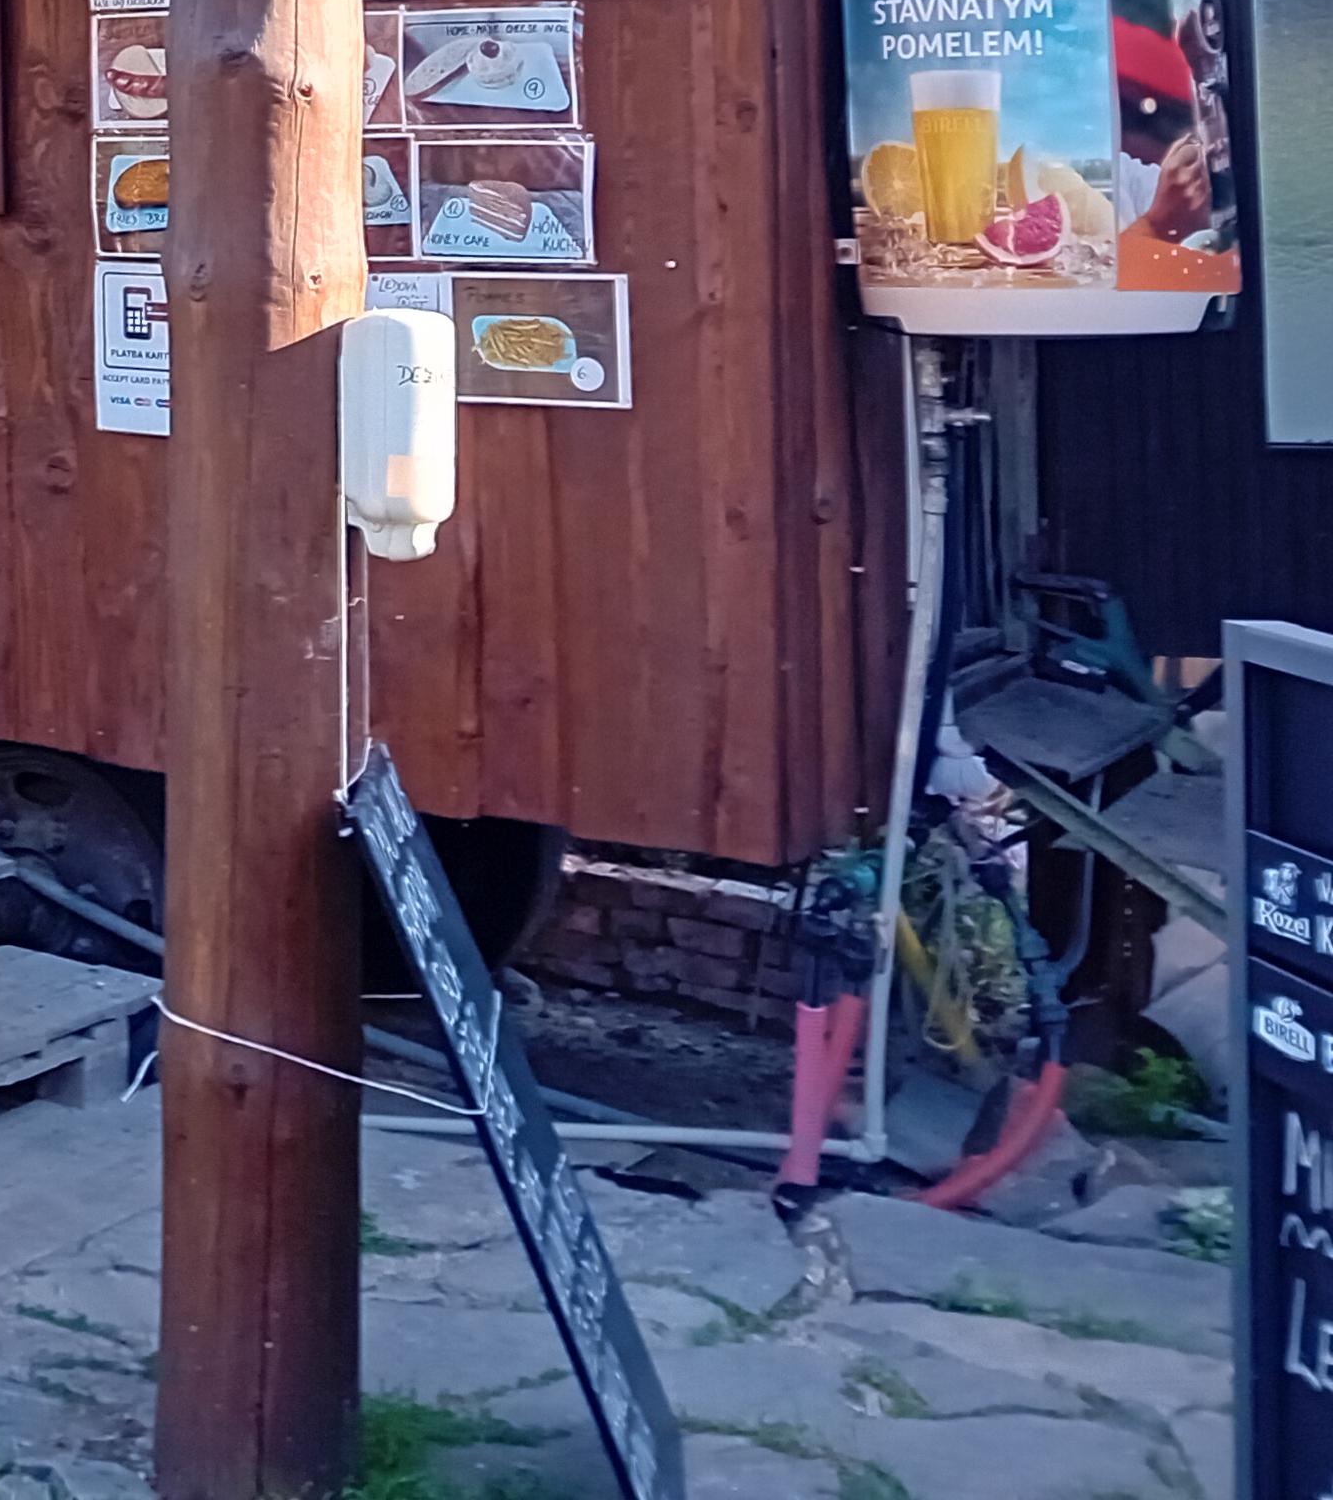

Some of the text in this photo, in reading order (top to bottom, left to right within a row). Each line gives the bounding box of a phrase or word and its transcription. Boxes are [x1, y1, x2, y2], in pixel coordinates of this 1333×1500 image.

[882, 29, 1044, 60] POMELEM!
[1253, 896, 1311, 946] Kozel
[1263, 1015, 1311, 1055] BIRELL
